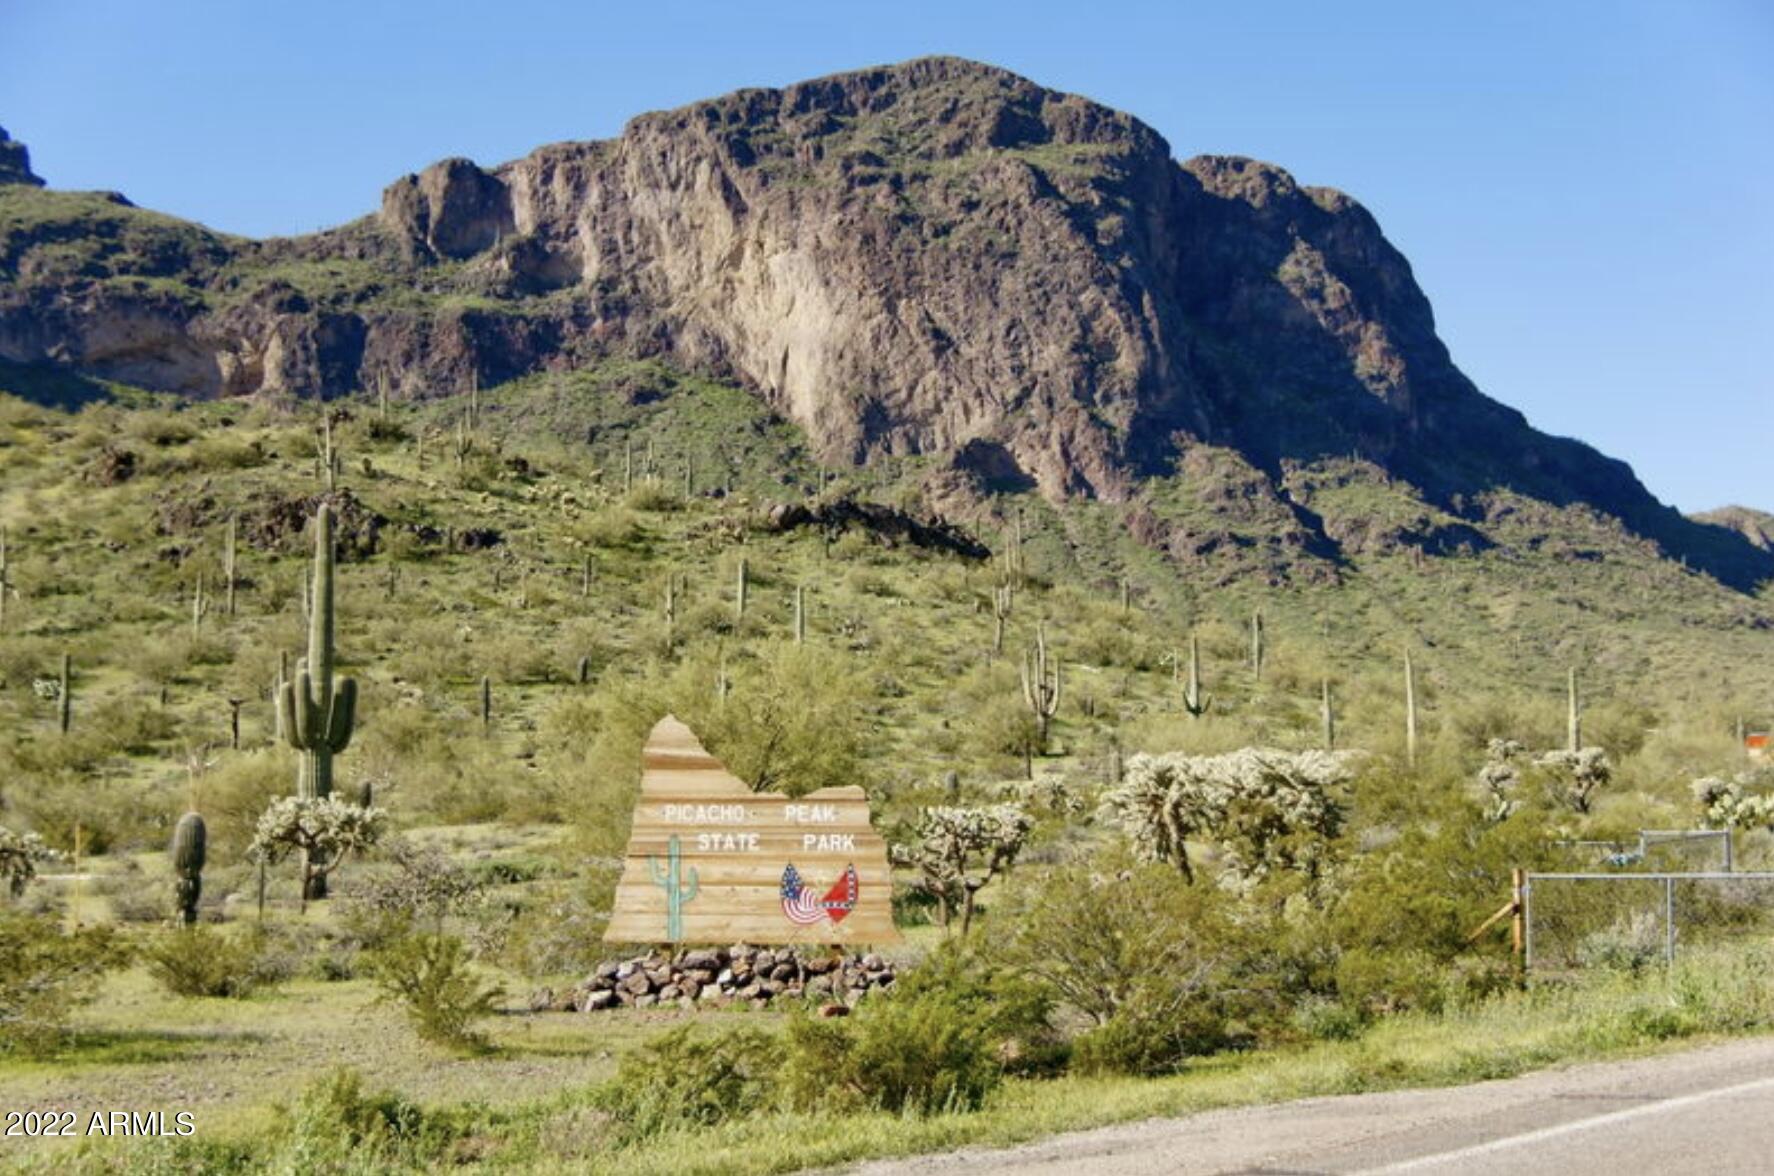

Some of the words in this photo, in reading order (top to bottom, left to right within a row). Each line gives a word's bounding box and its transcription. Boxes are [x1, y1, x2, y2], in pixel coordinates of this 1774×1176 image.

[664, 805, 744, 822] PICACHO
[784, 805, 836, 822] PEAK
[698, 833, 760, 851] STATE
[803, 833, 855, 851] PARK
